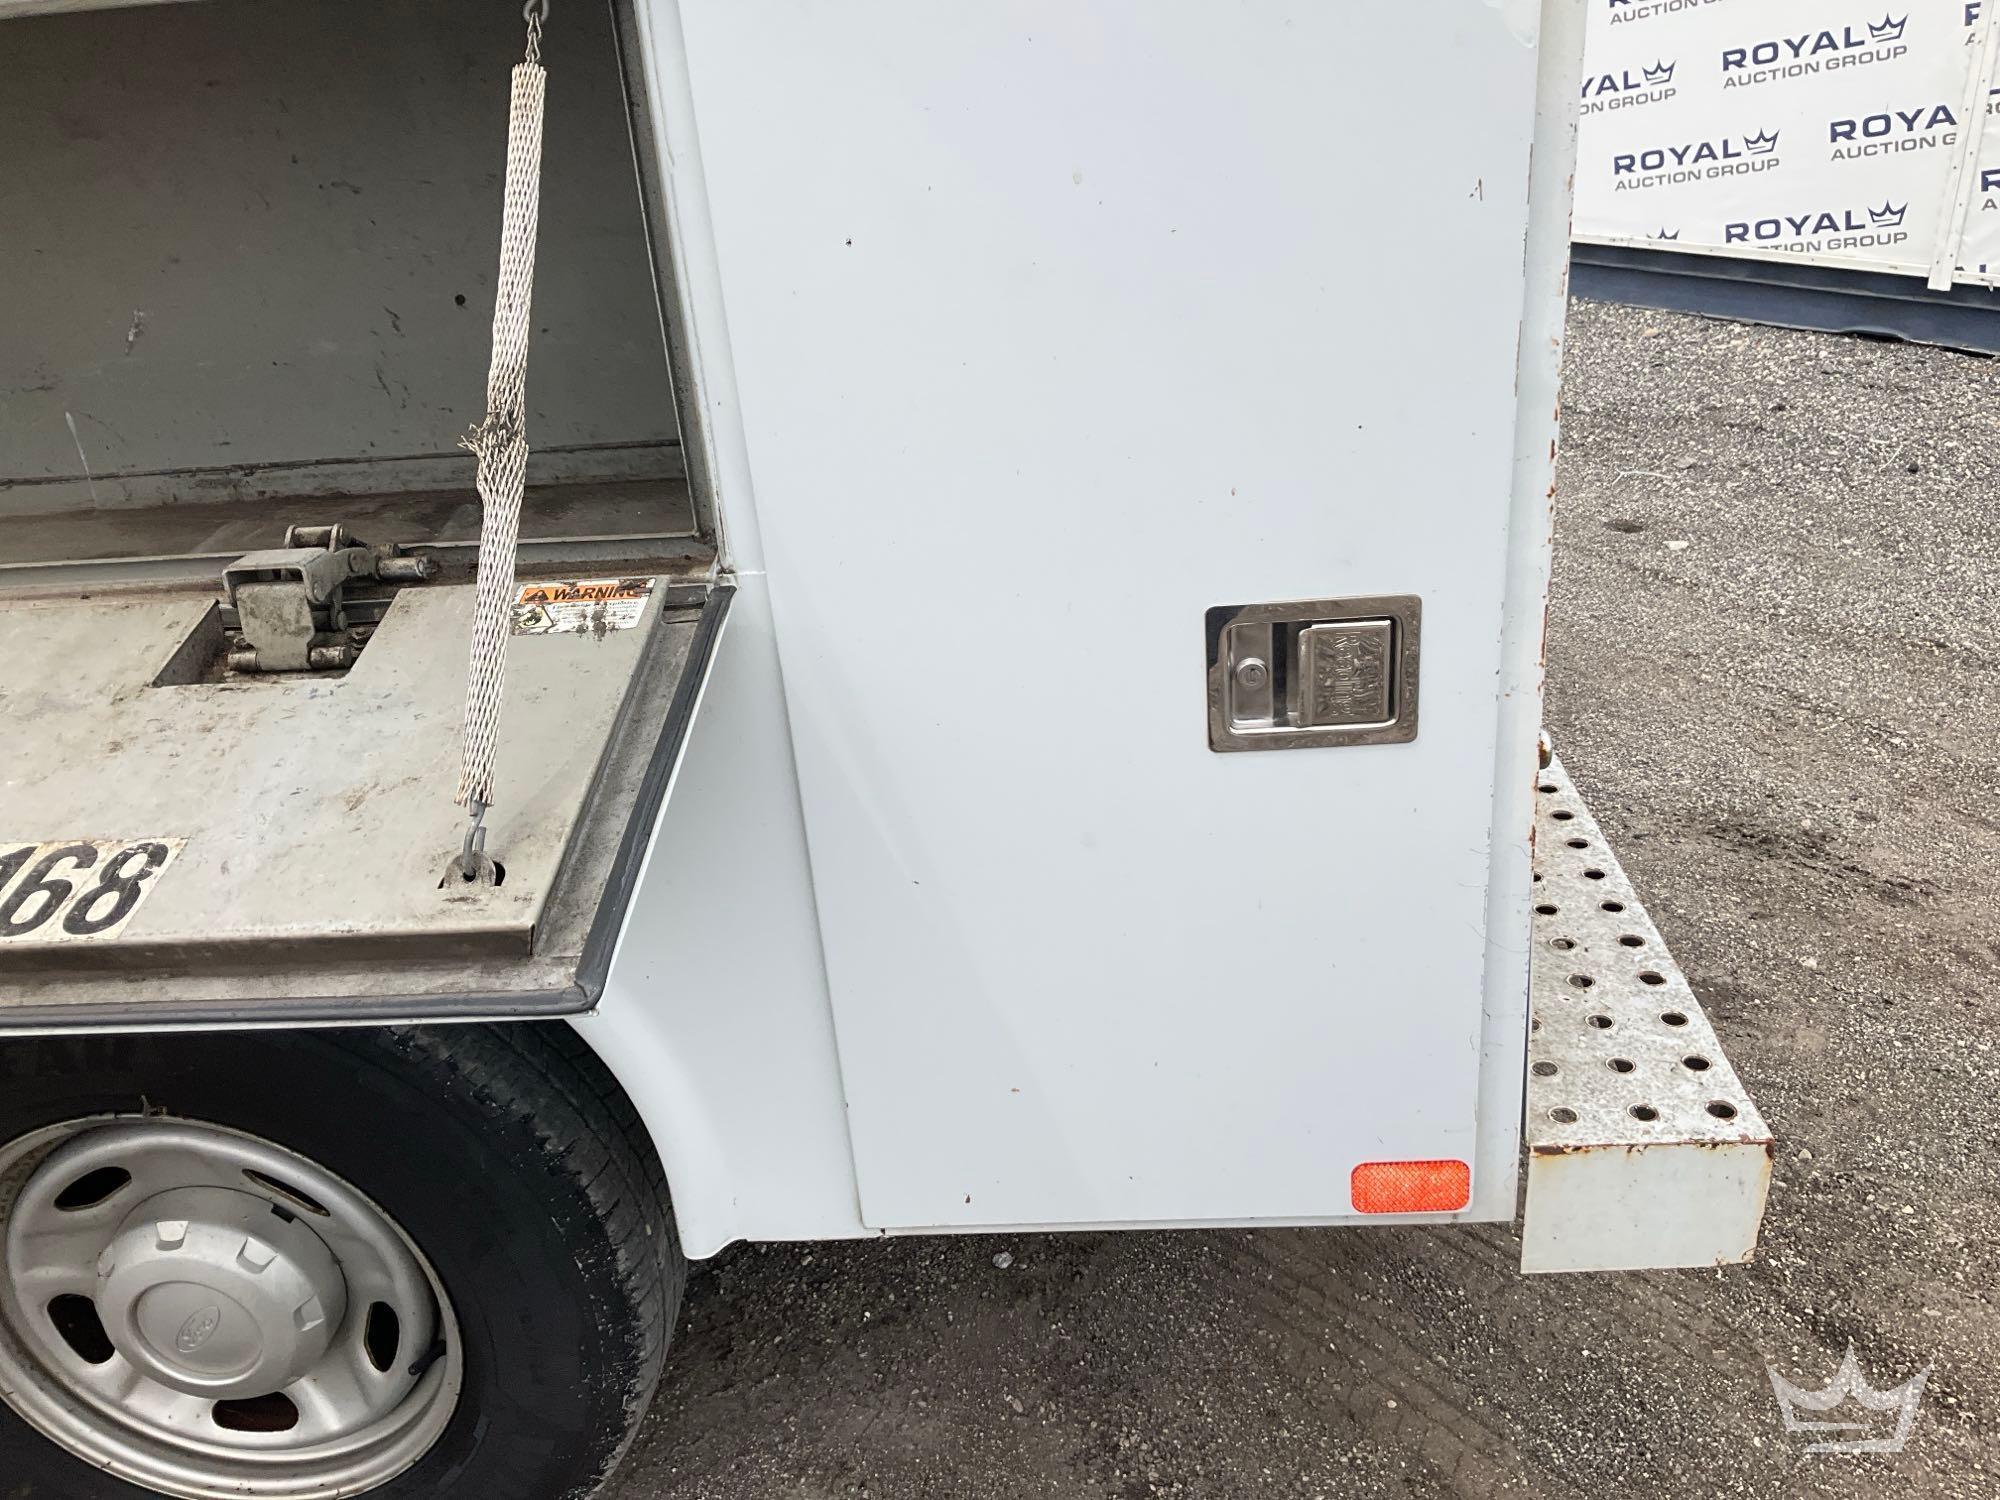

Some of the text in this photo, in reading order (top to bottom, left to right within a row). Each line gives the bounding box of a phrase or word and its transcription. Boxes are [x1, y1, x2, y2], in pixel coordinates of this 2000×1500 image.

[1609, 0, 1698, 25] AUCTION
[1722, 26, 1866, 72] ROYAL
[1723, 45, 1908, 89] AUCTION GROUP
[1608, 88, 1677, 110] GROUP
[1830, 105, 1958, 143] ROYA
[1614, 139, 1742, 175] ROYAL
[1831, 135, 1936, 162] AUCTION
[1614, 158, 1780, 192] AUCTION GROUP
[1725, 210, 1866, 244] ROYAL
[1827, 231, 1908, 251] GROUP
